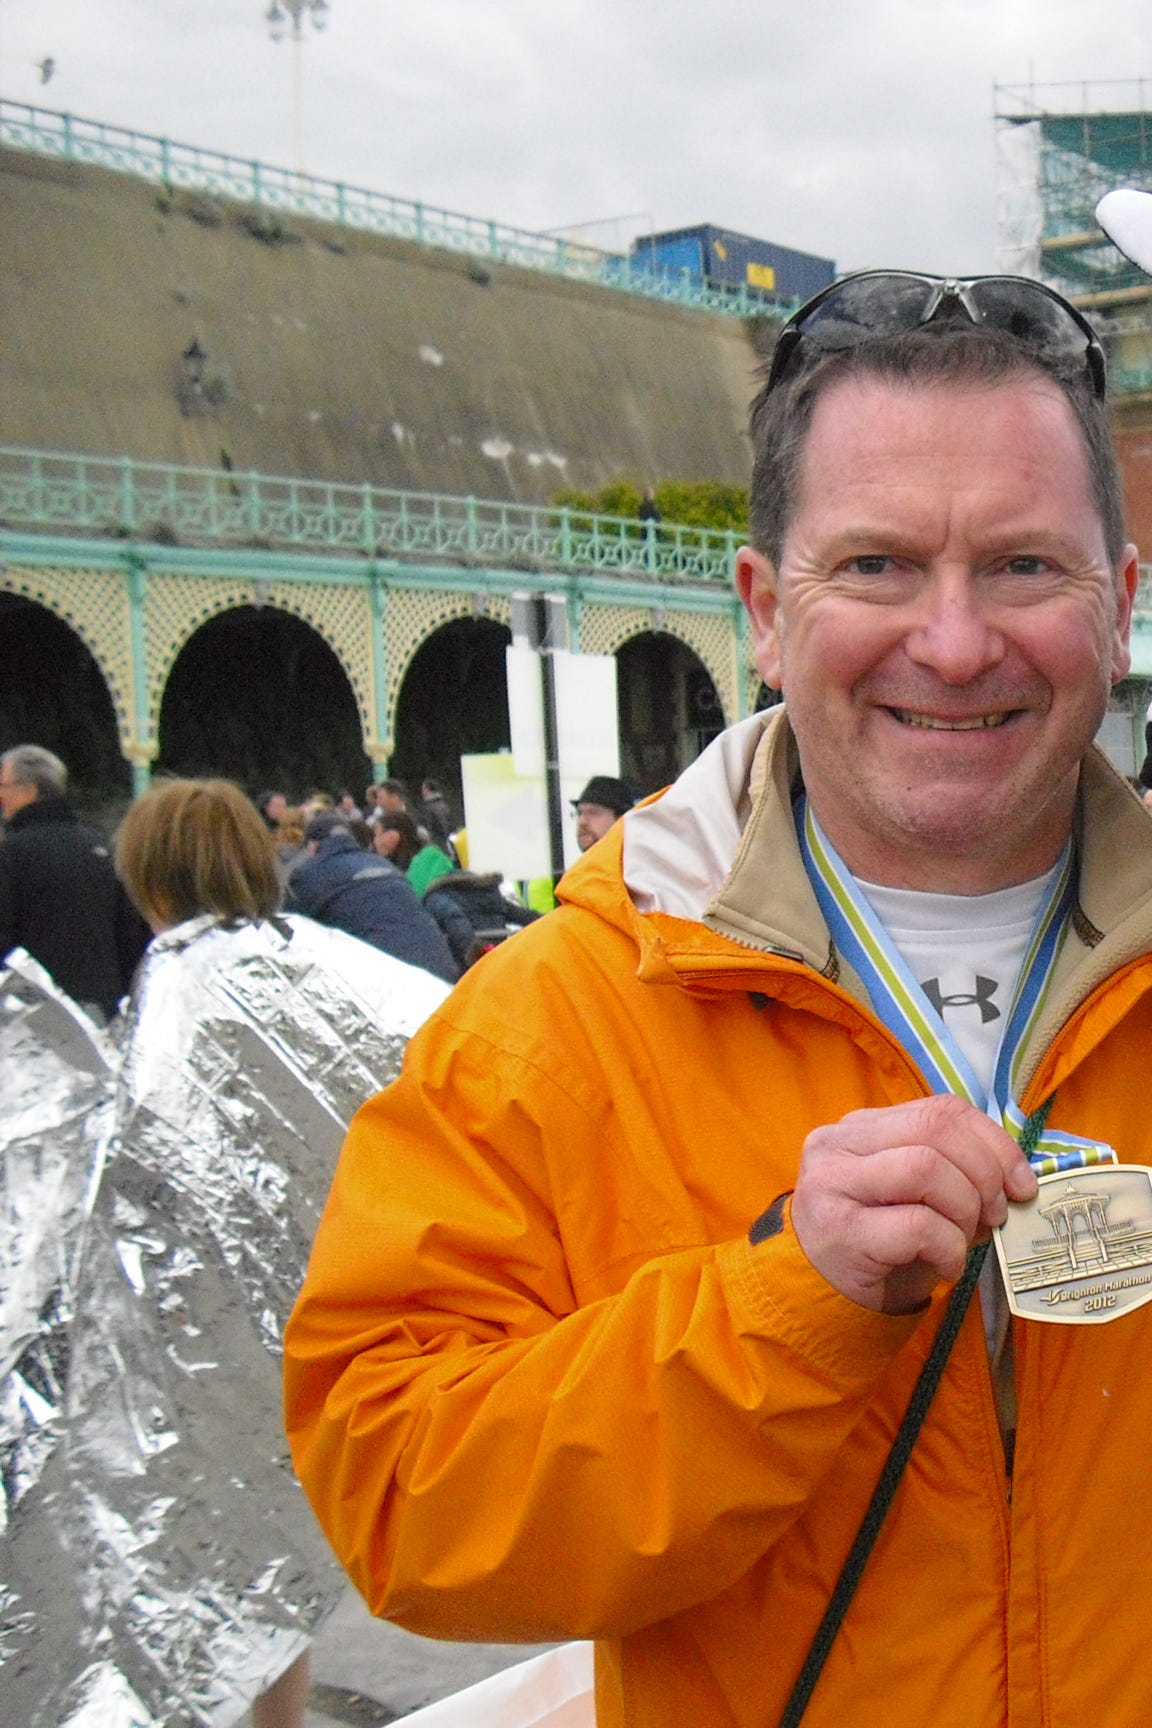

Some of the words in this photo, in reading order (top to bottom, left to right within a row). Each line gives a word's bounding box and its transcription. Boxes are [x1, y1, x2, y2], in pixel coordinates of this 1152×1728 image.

[1059, 1284, 1104, 1302] Brighton
[1104, 1273, 1152, 1292] Marathon
[1083, 1294, 1117, 1313] 2012
